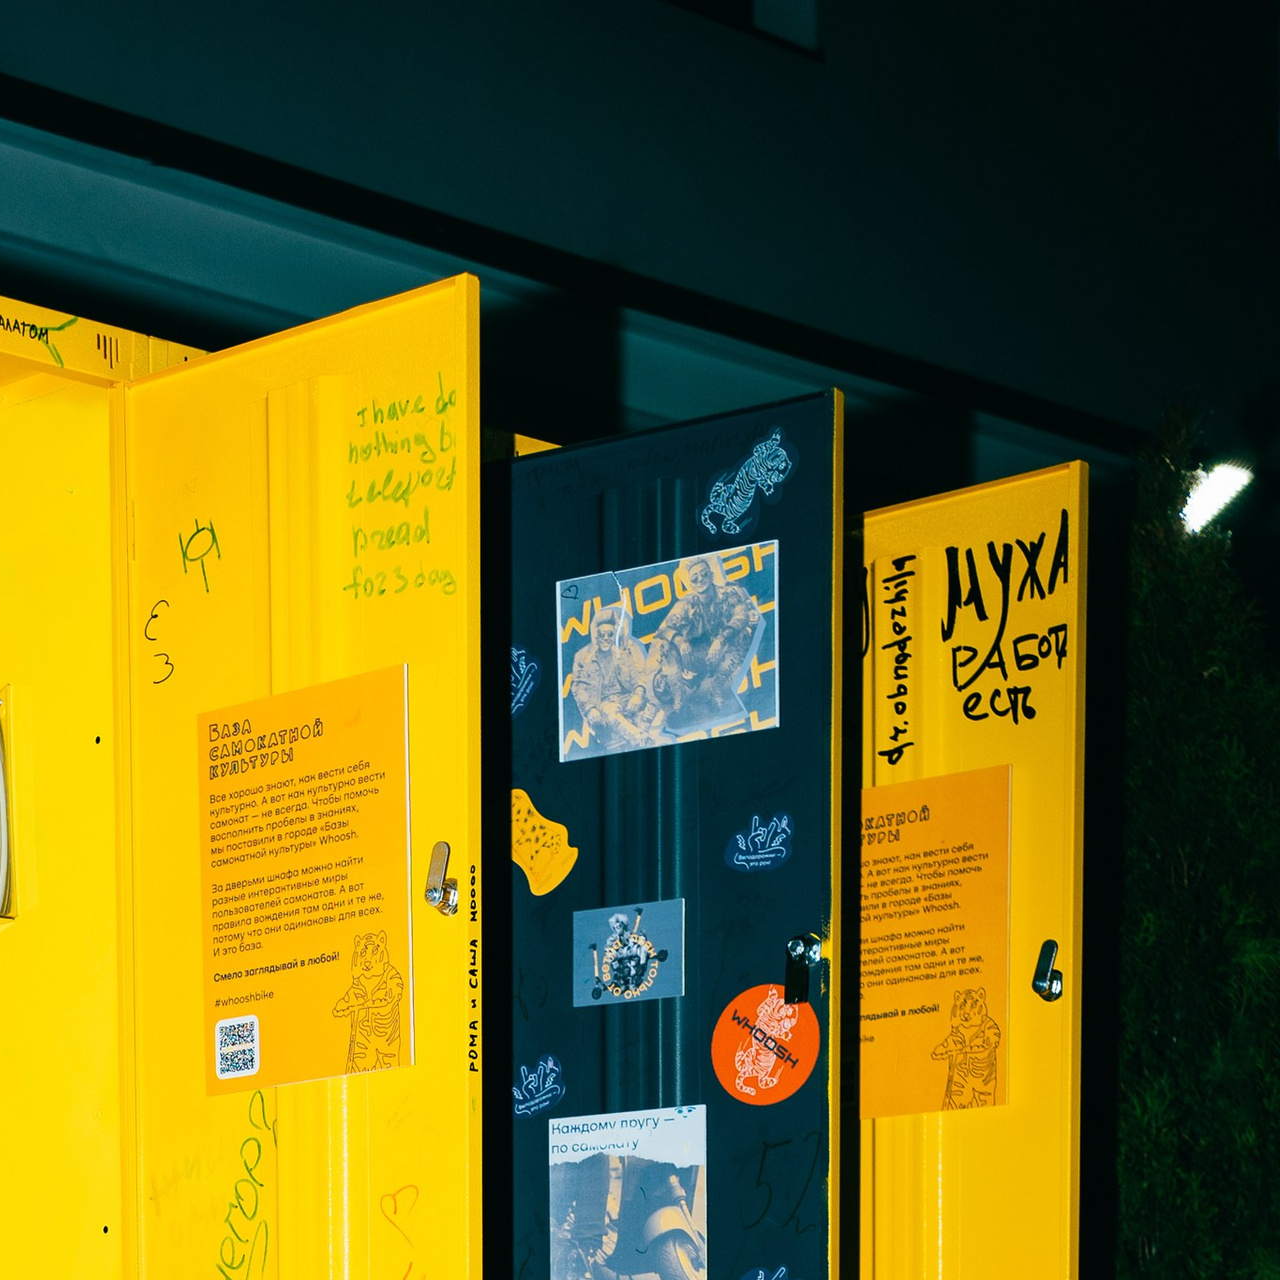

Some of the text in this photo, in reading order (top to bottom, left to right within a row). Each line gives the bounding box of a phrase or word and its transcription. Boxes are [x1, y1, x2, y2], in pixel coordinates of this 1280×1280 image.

[373, 398, 425, 424] have
[348, 430, 437, 465] nothing
[208, 793, 227, 804] Все
[228, 784, 264, 799] хорошо
[297, 773, 316, 784] как
[317, 766, 345, 780] вести
[346, 759, 370, 773] себя
[260, 795, 268, 805] А
[269, 793, 286, 804] вот
[287, 789, 305, 799] как
[306, 777, 356, 797] культурно
[357, 771, 385, 784] вести
[209, 814, 249, 830] самокат
[260, 809, 273, 818] не
[311, 792, 341, 806] Чтобы
[343, 787, 379, 800] помочь
[209, 824, 264, 843] восполнить
[265, 815, 307, 831] пробелы
[308, 813, 315, 822] в
[210, 819, 349, 855] мы поставили в городе «Базы
[210, 847, 266, 868] самокатной
[211, 855, 363, 894] За дверьми шкафа можно найти
[211, 872, 348, 908] разные интерактивные миры
[211, 896, 281, 919] пользователей
[338, 884, 346, 894] А
[348, 881, 364, 893] вот
[212, 917, 252, 933] правила
[253, 907, 300, 924] вождения
[301, 904, 319, 914] там
[321, 899, 345, 911] одни
[347, 897, 354, 906] и
[355, 894, 366, 903] те
[212, 931, 245, 944] потому
[246, 927, 262, 937] что
[263, 924, 281, 935] они
[282, 914, 336, 931] одинаковы
[337, 910, 356, 922] для
[212, 946, 220, 957] И
[221, 945, 237, 956] это
[468, 938, 479, 989] САША
[212, 970, 243, 983] Смело
[243, 957, 298, 977] заглядывай
[299, 958, 306, 967] в
[214, 989, 274, 1007] #whooshbike
[468, 1019, 480, 1073] РОМА
[730, 1008, 799, 1069] WHOOSH
[551, 1144, 568, 1154] по
